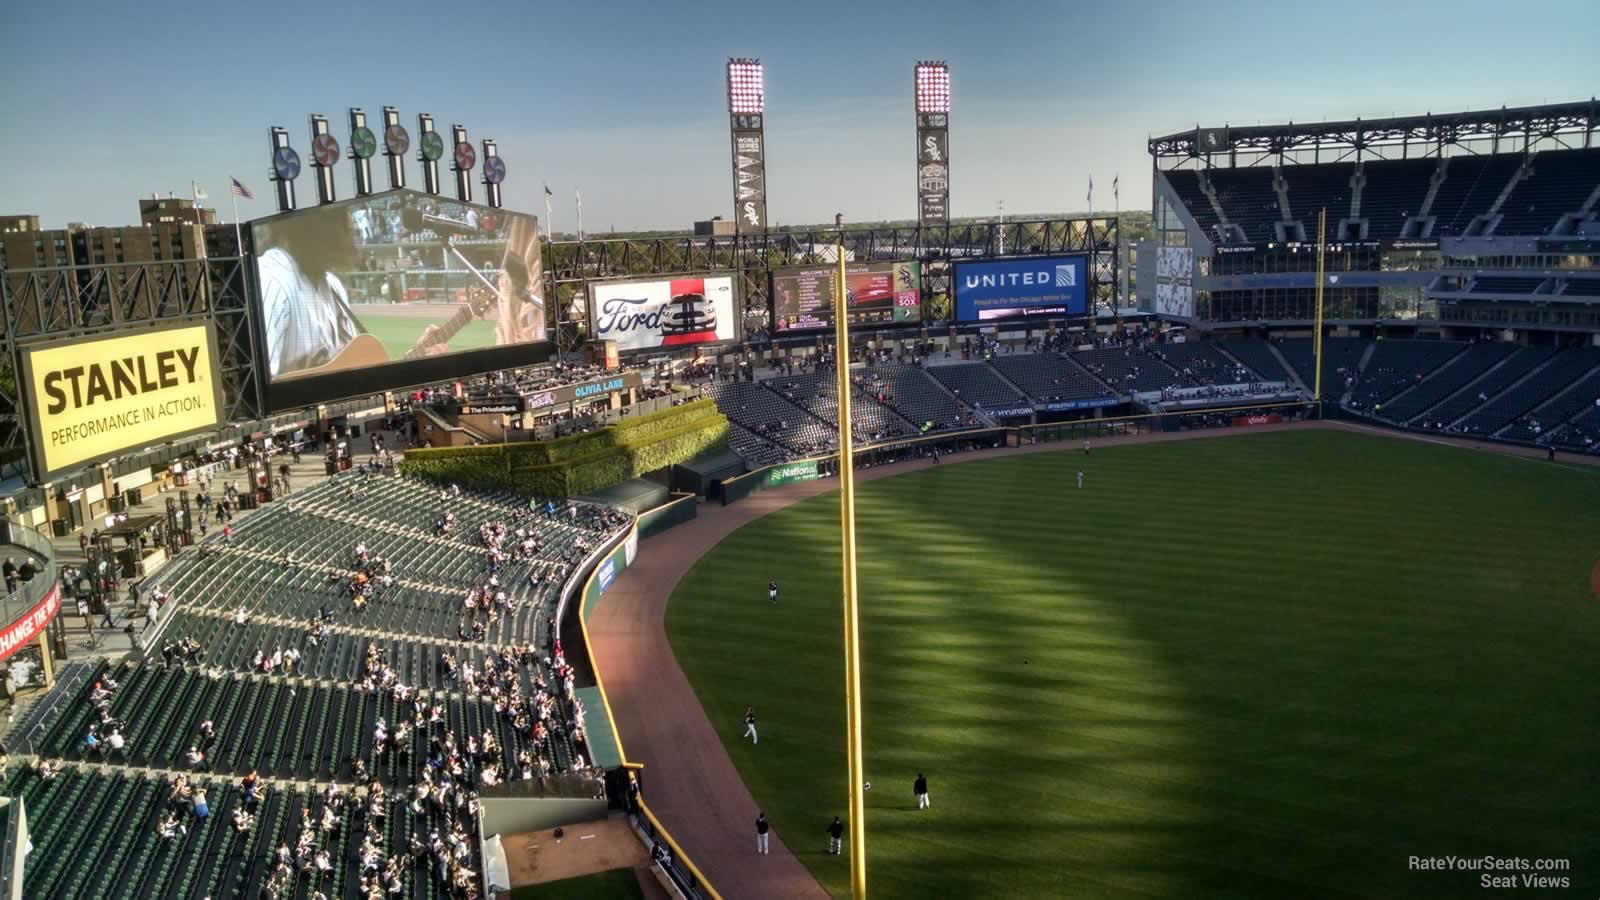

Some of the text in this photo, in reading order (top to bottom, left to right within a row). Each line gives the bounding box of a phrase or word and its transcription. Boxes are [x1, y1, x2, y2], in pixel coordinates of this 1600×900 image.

[966, 271, 1050, 288] UNITED
[597, 297, 667, 334] Ford
[44, 346, 200, 415] STANLEY
[575, 379, 625, 397] OLIVIA LANE
[482, 406, 518, 414] PrivateBank
[998, 407, 1033, 416] HYUNDAI
[51, 396, 201, 447] PERFORMANCE IN ACTION
[782, 464, 817, 477] National
[0, 616, 35, 654] HANGE
[34, 604, 48, 628] THE
